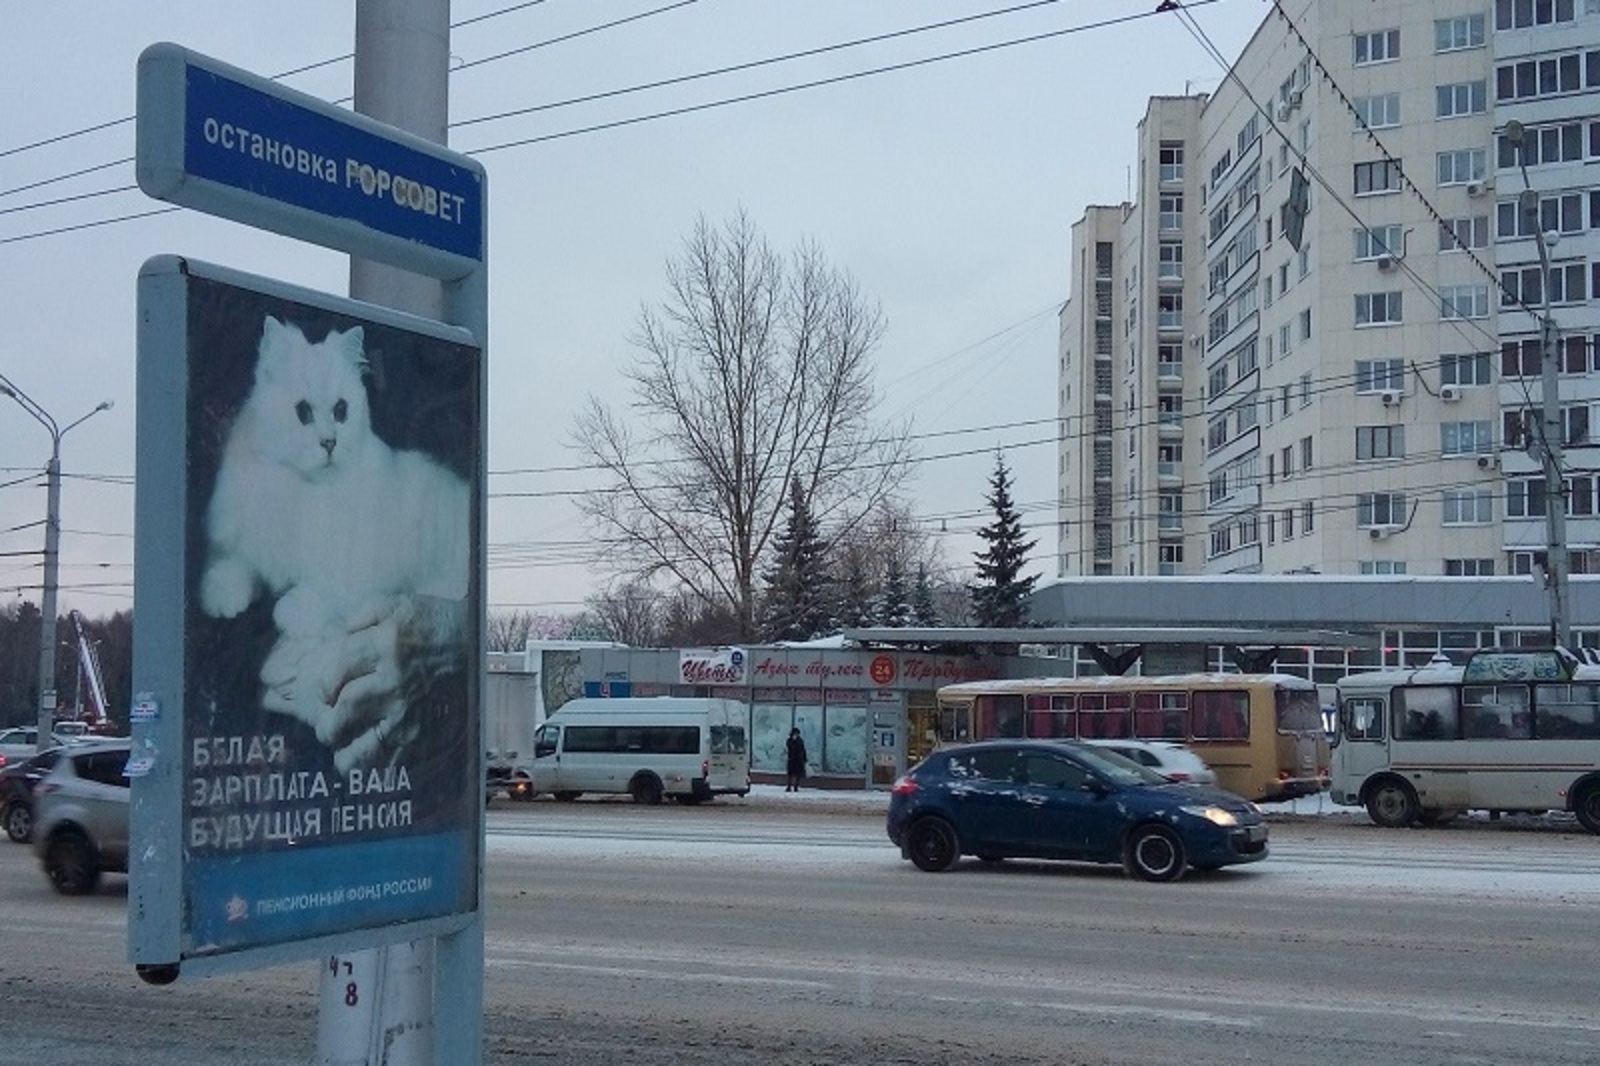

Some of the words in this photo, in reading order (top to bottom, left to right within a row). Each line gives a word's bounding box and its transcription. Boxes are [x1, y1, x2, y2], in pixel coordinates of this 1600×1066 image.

[345, 157, 465, 225] ГОРСОВЕТ
[681, 659, 738, 683] Цветы
[874, 665, 891, 675] 24
[192, 734, 286, 768] БЕЛАЯ
[190, 770, 329, 807] ЗАРПЛАТА
[349, 765, 412, 795] ВАША
[190, 808, 321, 849] БУДУЩАЯ
[331, 800, 412, 834] ПЕНСИЯ
[256, 886, 345, 916] ПЕНСИОННЫЙ
[346, 883, 381, 900] ФОНД
[345, 981, 359, 1007] 8
